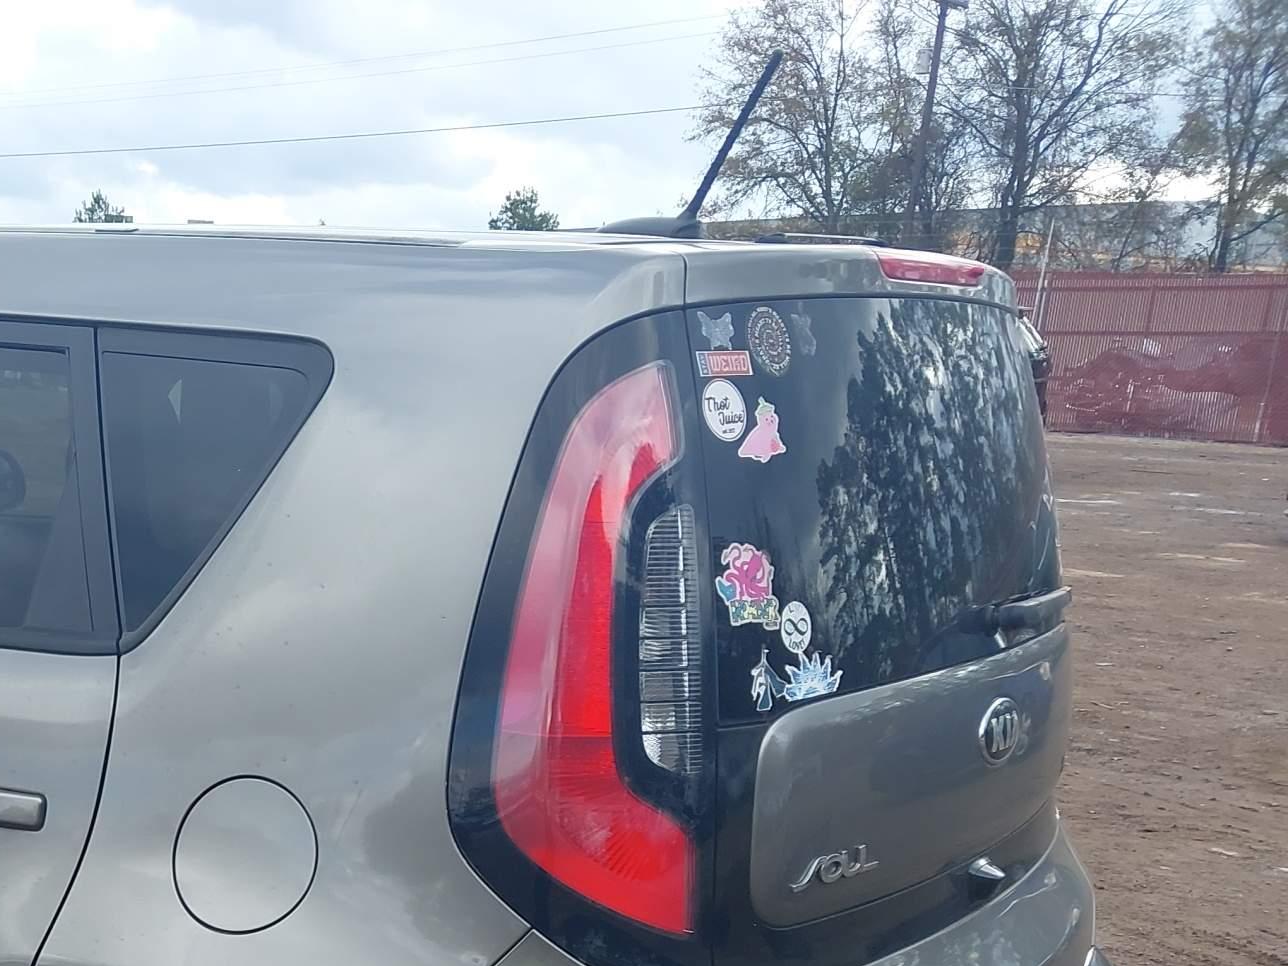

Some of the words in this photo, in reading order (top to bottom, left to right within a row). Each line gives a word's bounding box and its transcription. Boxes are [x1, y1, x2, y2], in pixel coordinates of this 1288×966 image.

[708, 355, 748, 371] WEIRD
[704, 396, 731, 413] Thot
[717, 410, 745, 426] Juice
[990, 709, 1019, 753] KIA
[788, 844, 880, 893] SOUL
